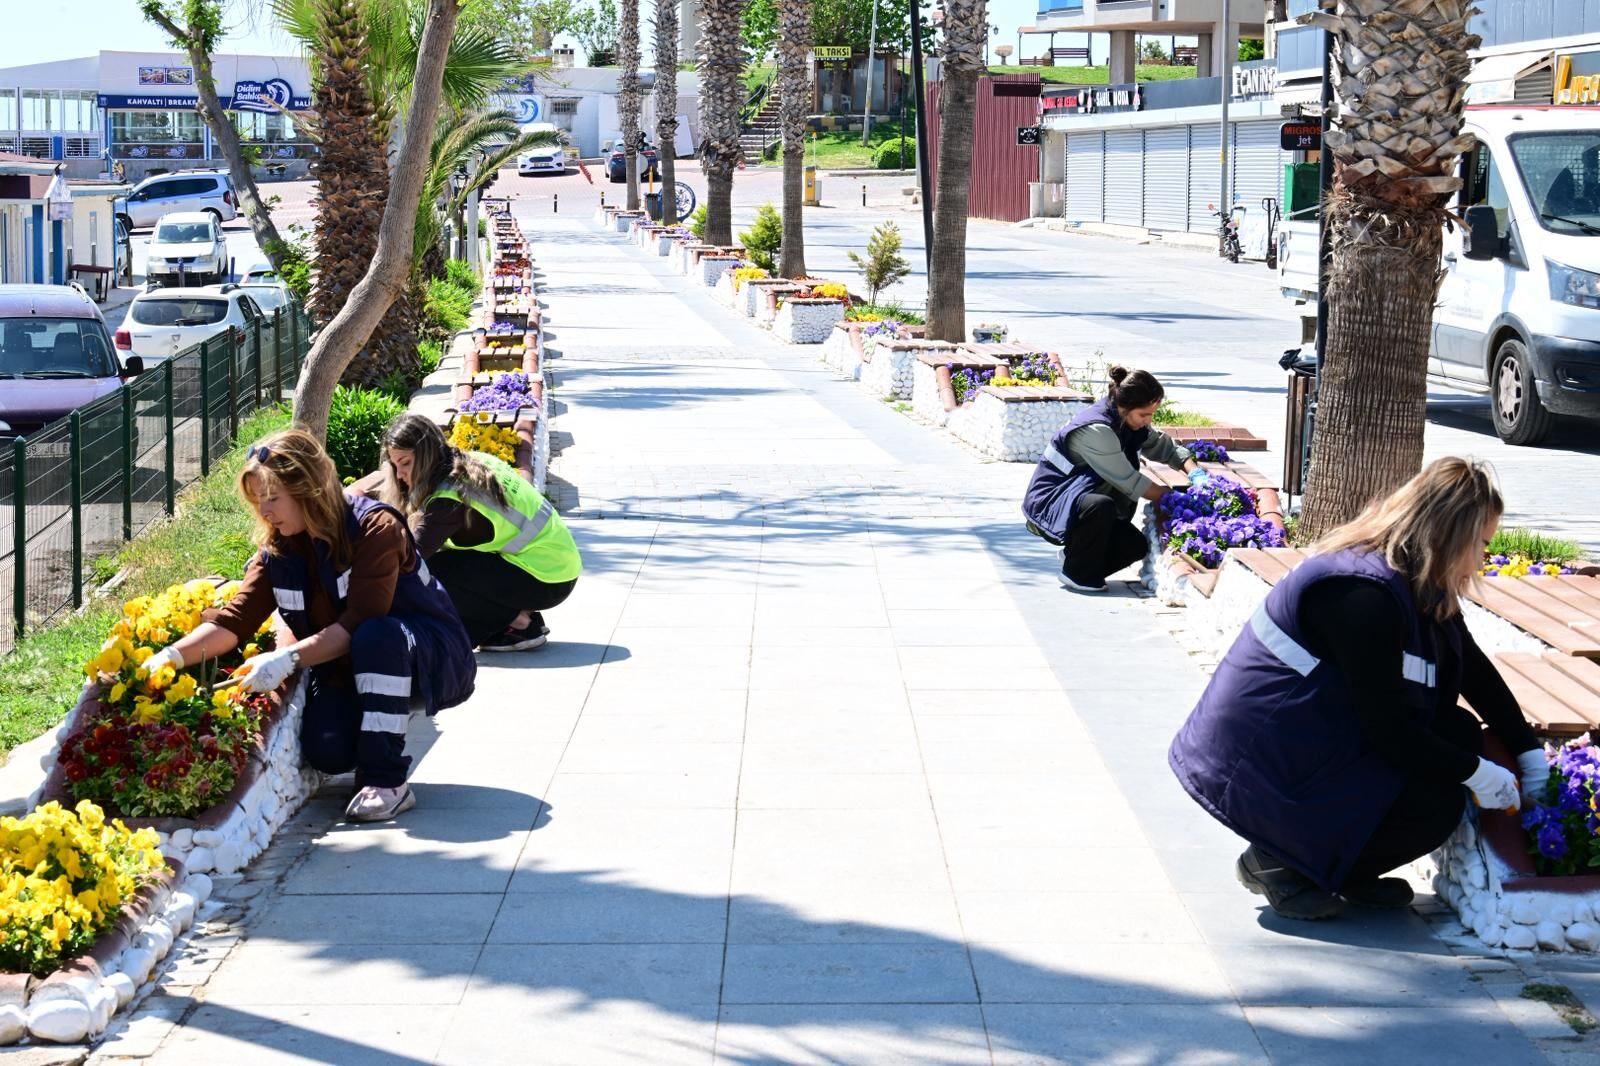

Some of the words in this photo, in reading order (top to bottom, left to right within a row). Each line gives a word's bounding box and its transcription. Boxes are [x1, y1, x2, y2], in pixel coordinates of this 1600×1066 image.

[236, 84, 261, 94] Didim
[127, 98, 163, 106] KAHVALTI
[1284, 126, 1322, 134] MIGROS
[1296, 136, 1312, 147] jet
